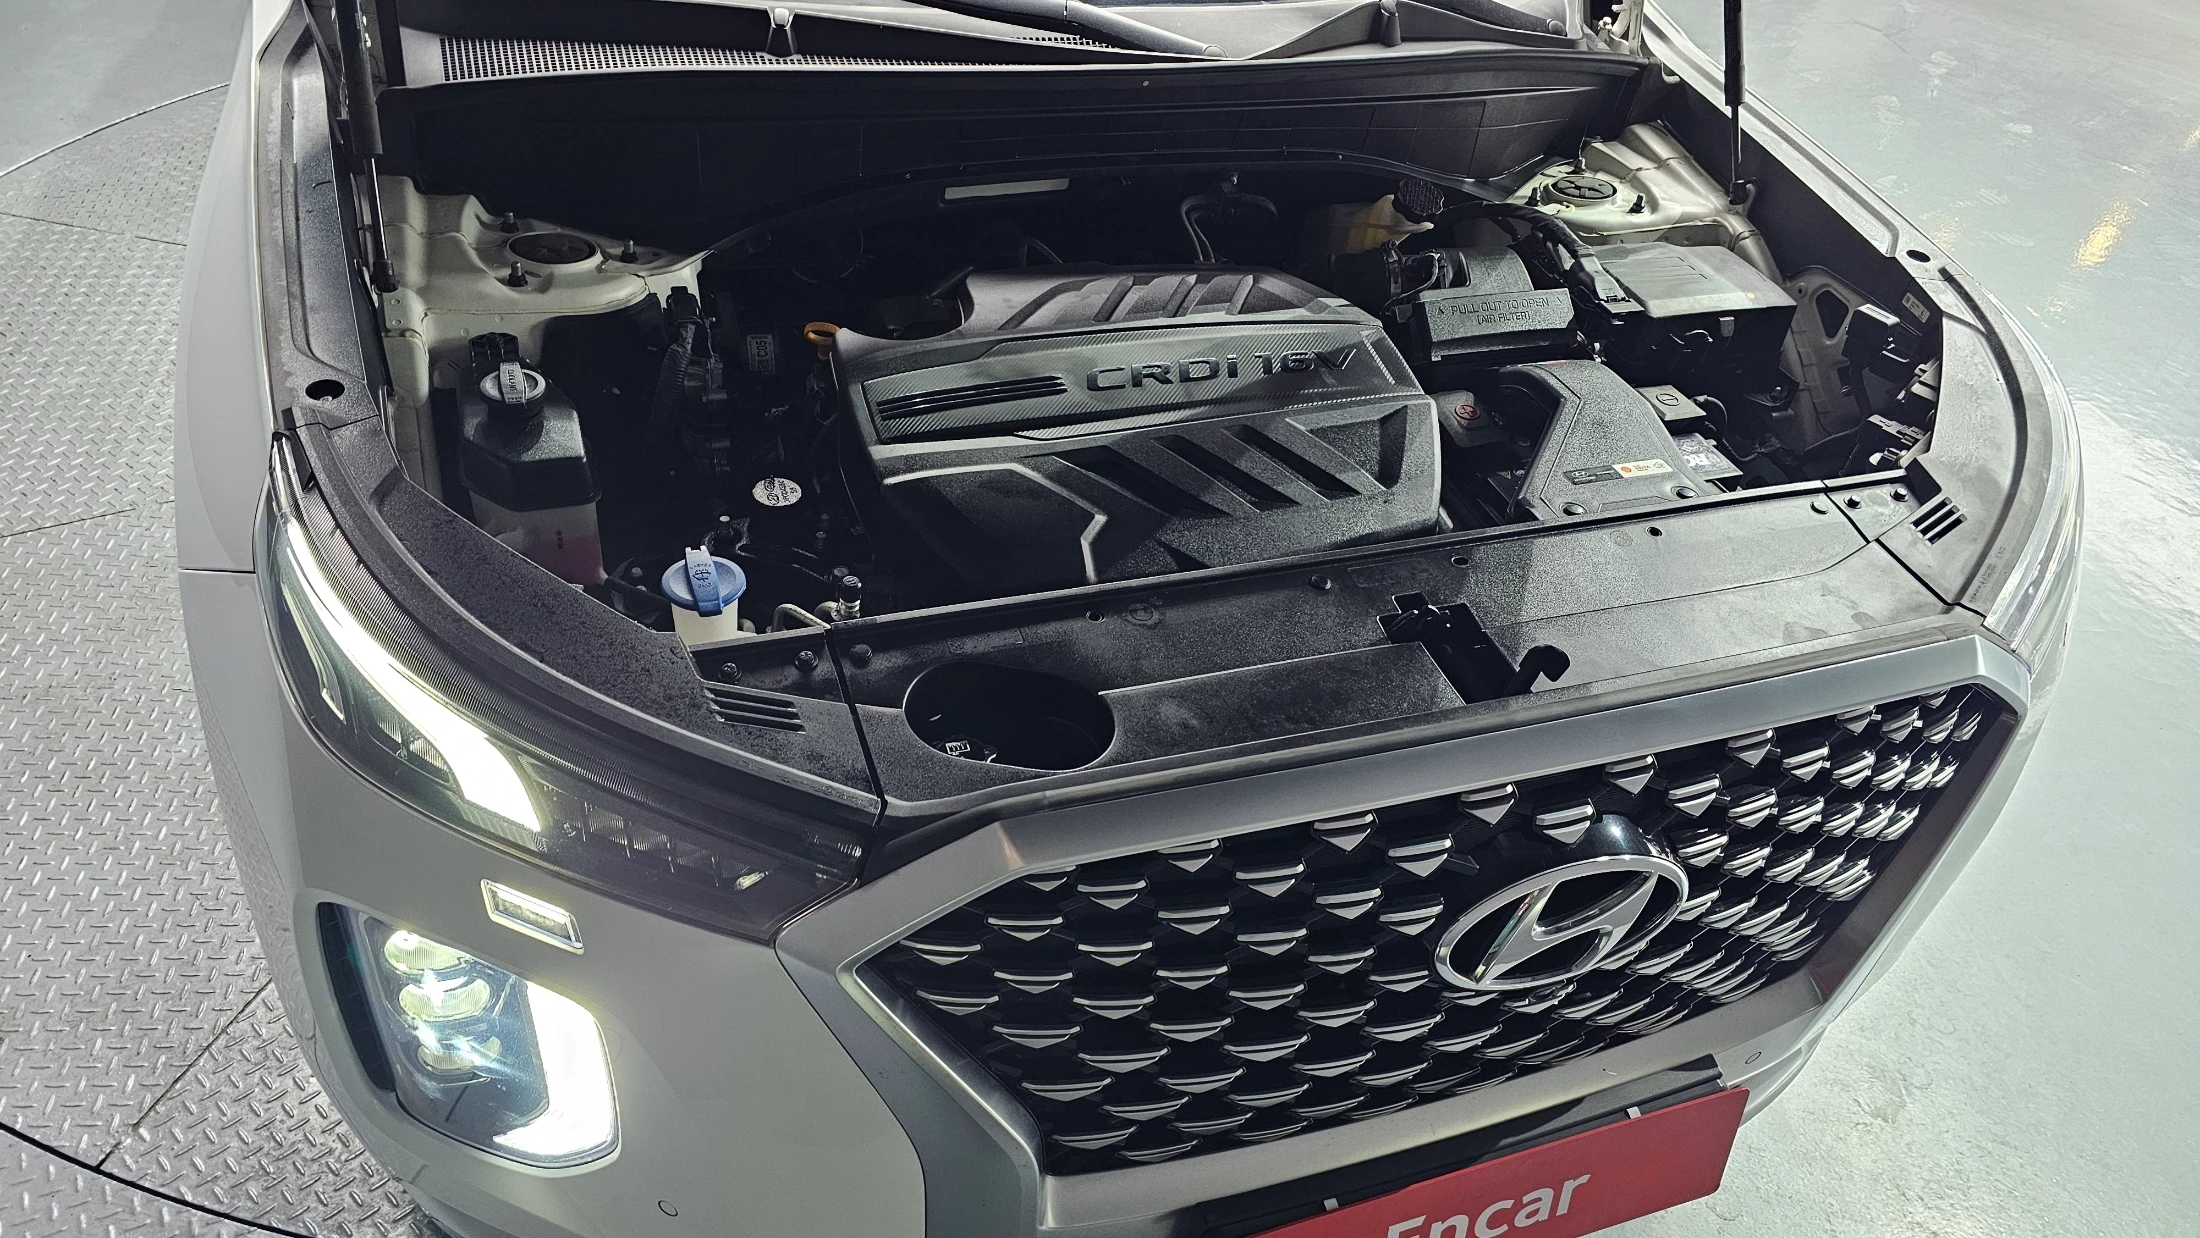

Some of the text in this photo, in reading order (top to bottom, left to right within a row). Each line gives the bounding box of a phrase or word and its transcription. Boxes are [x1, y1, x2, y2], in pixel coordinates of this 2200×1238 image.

[1450, 297, 1550, 315] PULL OUT TO OPEN
[1477, 311, 1531, 325] (AIR FILTER)
[1254, 349, 1356, 377] 16V
